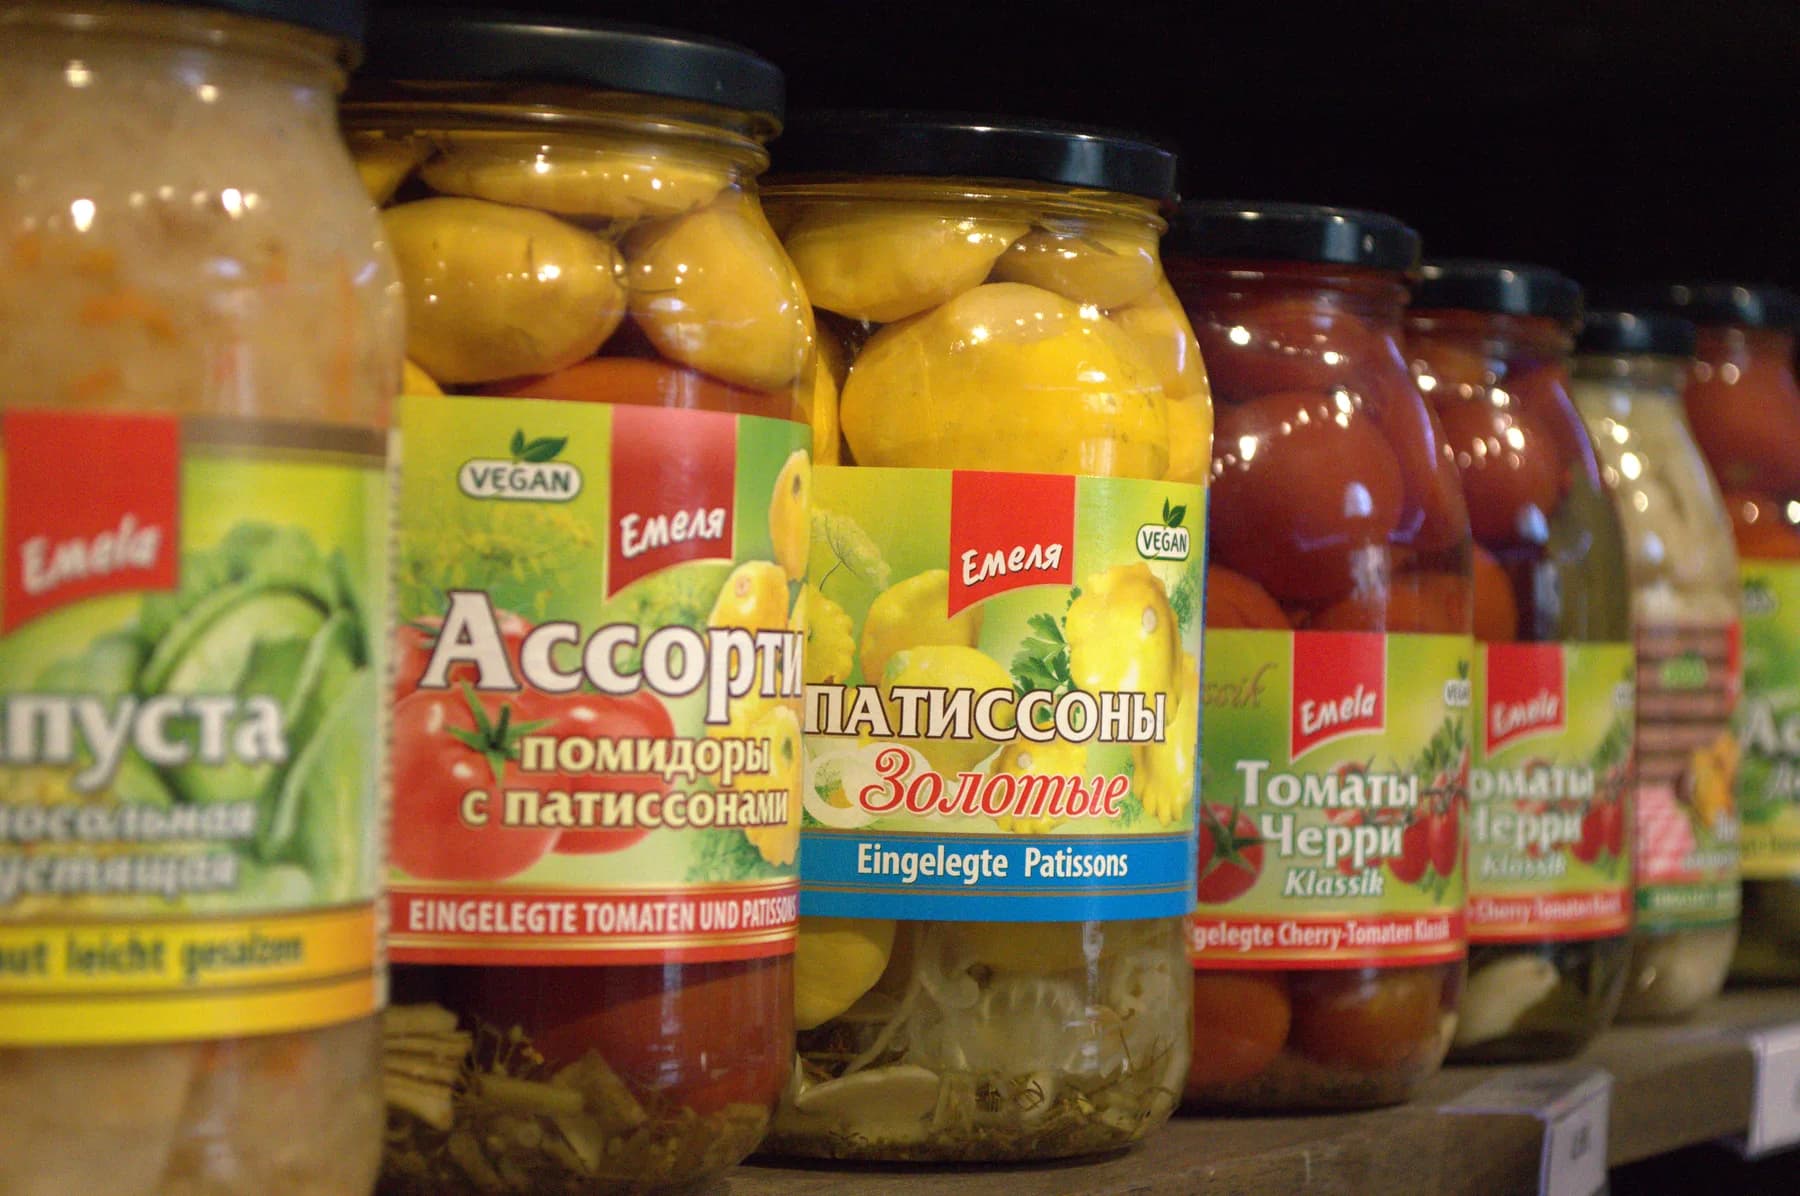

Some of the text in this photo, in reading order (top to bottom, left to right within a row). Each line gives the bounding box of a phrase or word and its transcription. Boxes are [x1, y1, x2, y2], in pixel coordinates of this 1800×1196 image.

[469, 466, 571, 493] VEGAN
[620, 506, 726, 558] Емеля
[1142, 530, 1187, 552] VEGAN
[961, 543, 1063, 587] Емеля
[418, 589, 803, 724] Ассорти
[804, 683, 1166, 743] ПАТИССОНЫ
[0, 692, 289, 792] пуста
[520, 736, 771, 786] помидоры
[858, 746, 1130, 819] Золотые
[1236, 760, 1419, 808] Томаты
[1468, 767, 1595, 799] оматы
[461, 789, 790, 828] с патиссонами
[1261, 814, 1404, 869] Черри
[857, 843, 1129, 885] Eingelegte Patissons
[1282, 867, 1386, 897] Klassik
[409, 894, 798, 933] EINGELEGTE TOMATEN UND PATISSONS
[1193, 920, 1274, 951] gelegte
[1278, 919, 1414, 950] Cherry-Tomaten
